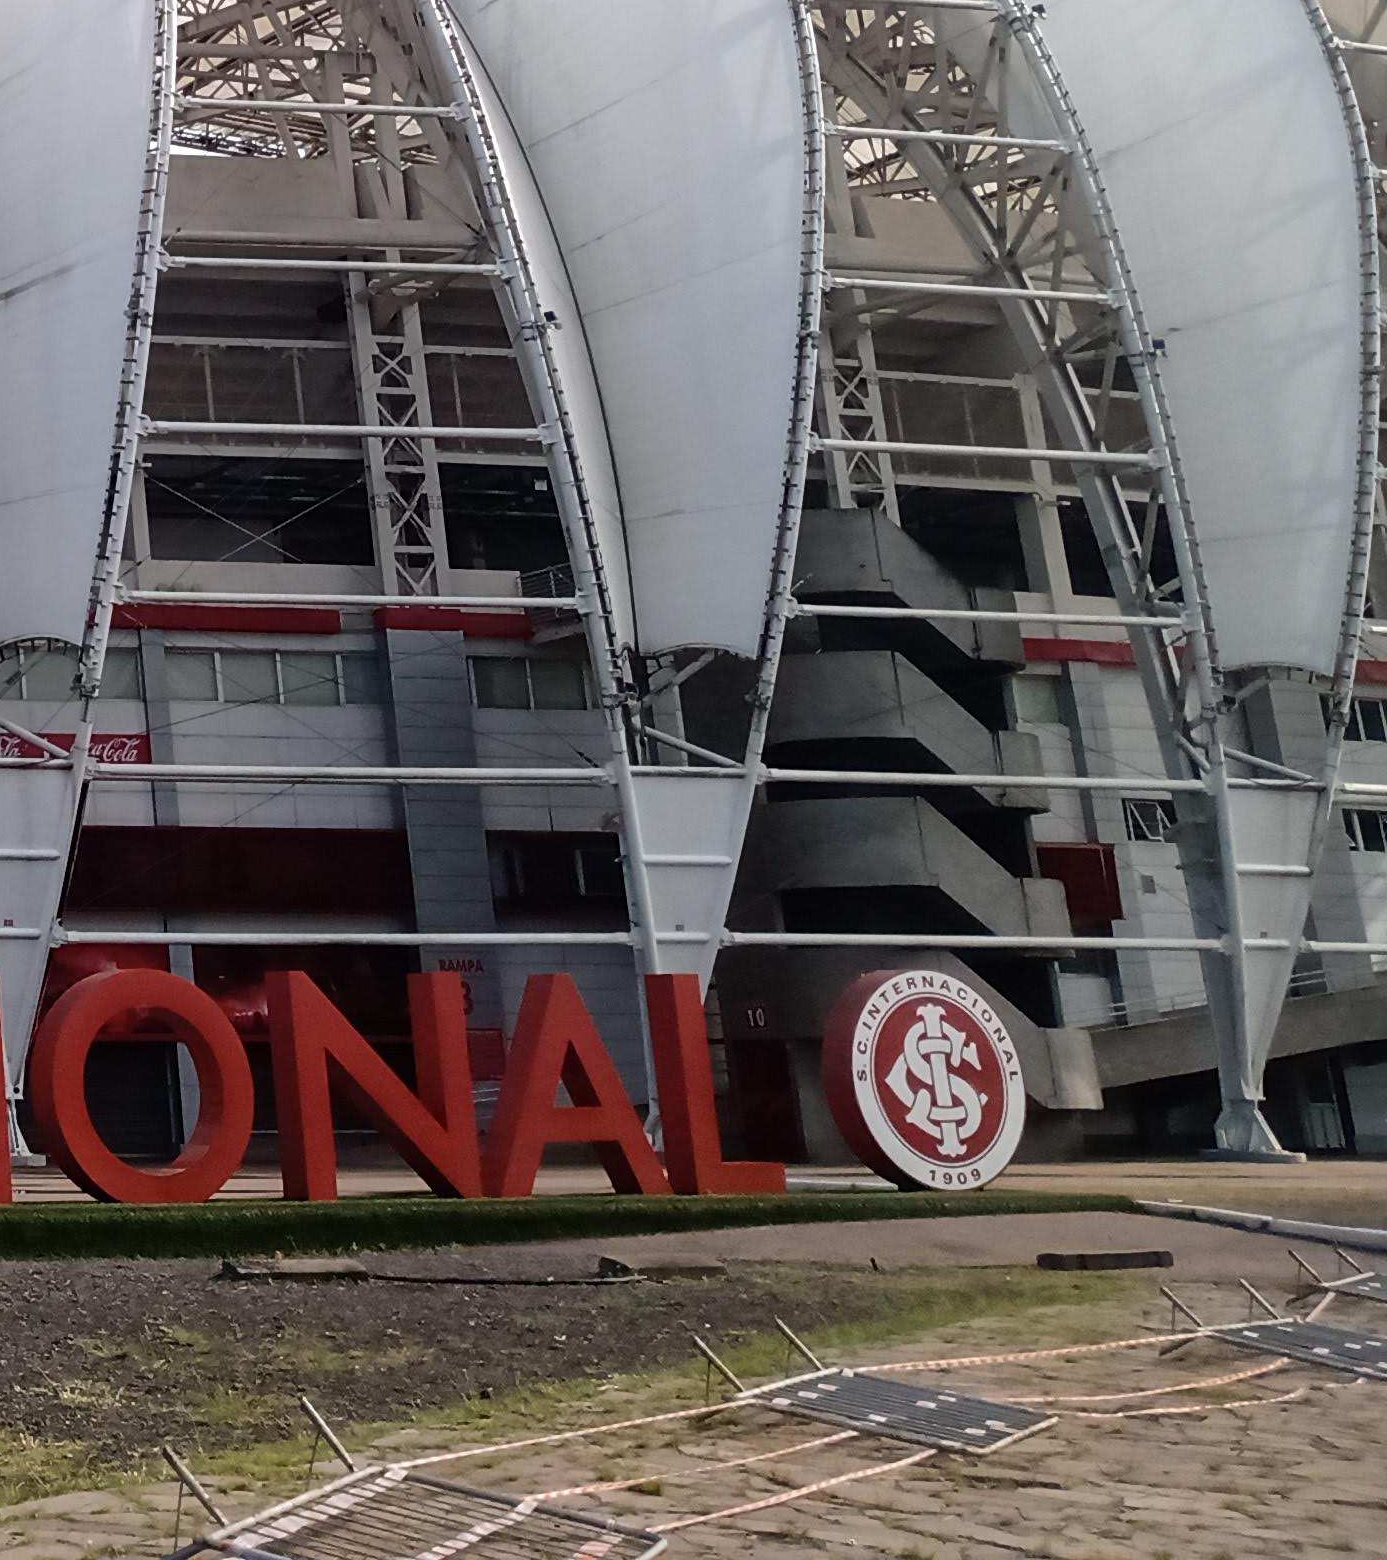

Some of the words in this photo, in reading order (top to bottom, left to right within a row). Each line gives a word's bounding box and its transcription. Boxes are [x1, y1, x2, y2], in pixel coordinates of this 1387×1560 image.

[437, 959, 484, 972] RAMPA
[747, 1008, 765, 1027] 10
[862, 976, 1019, 1082] INTERNACIONAL
[929, 1168, 982, 1185] 1909
